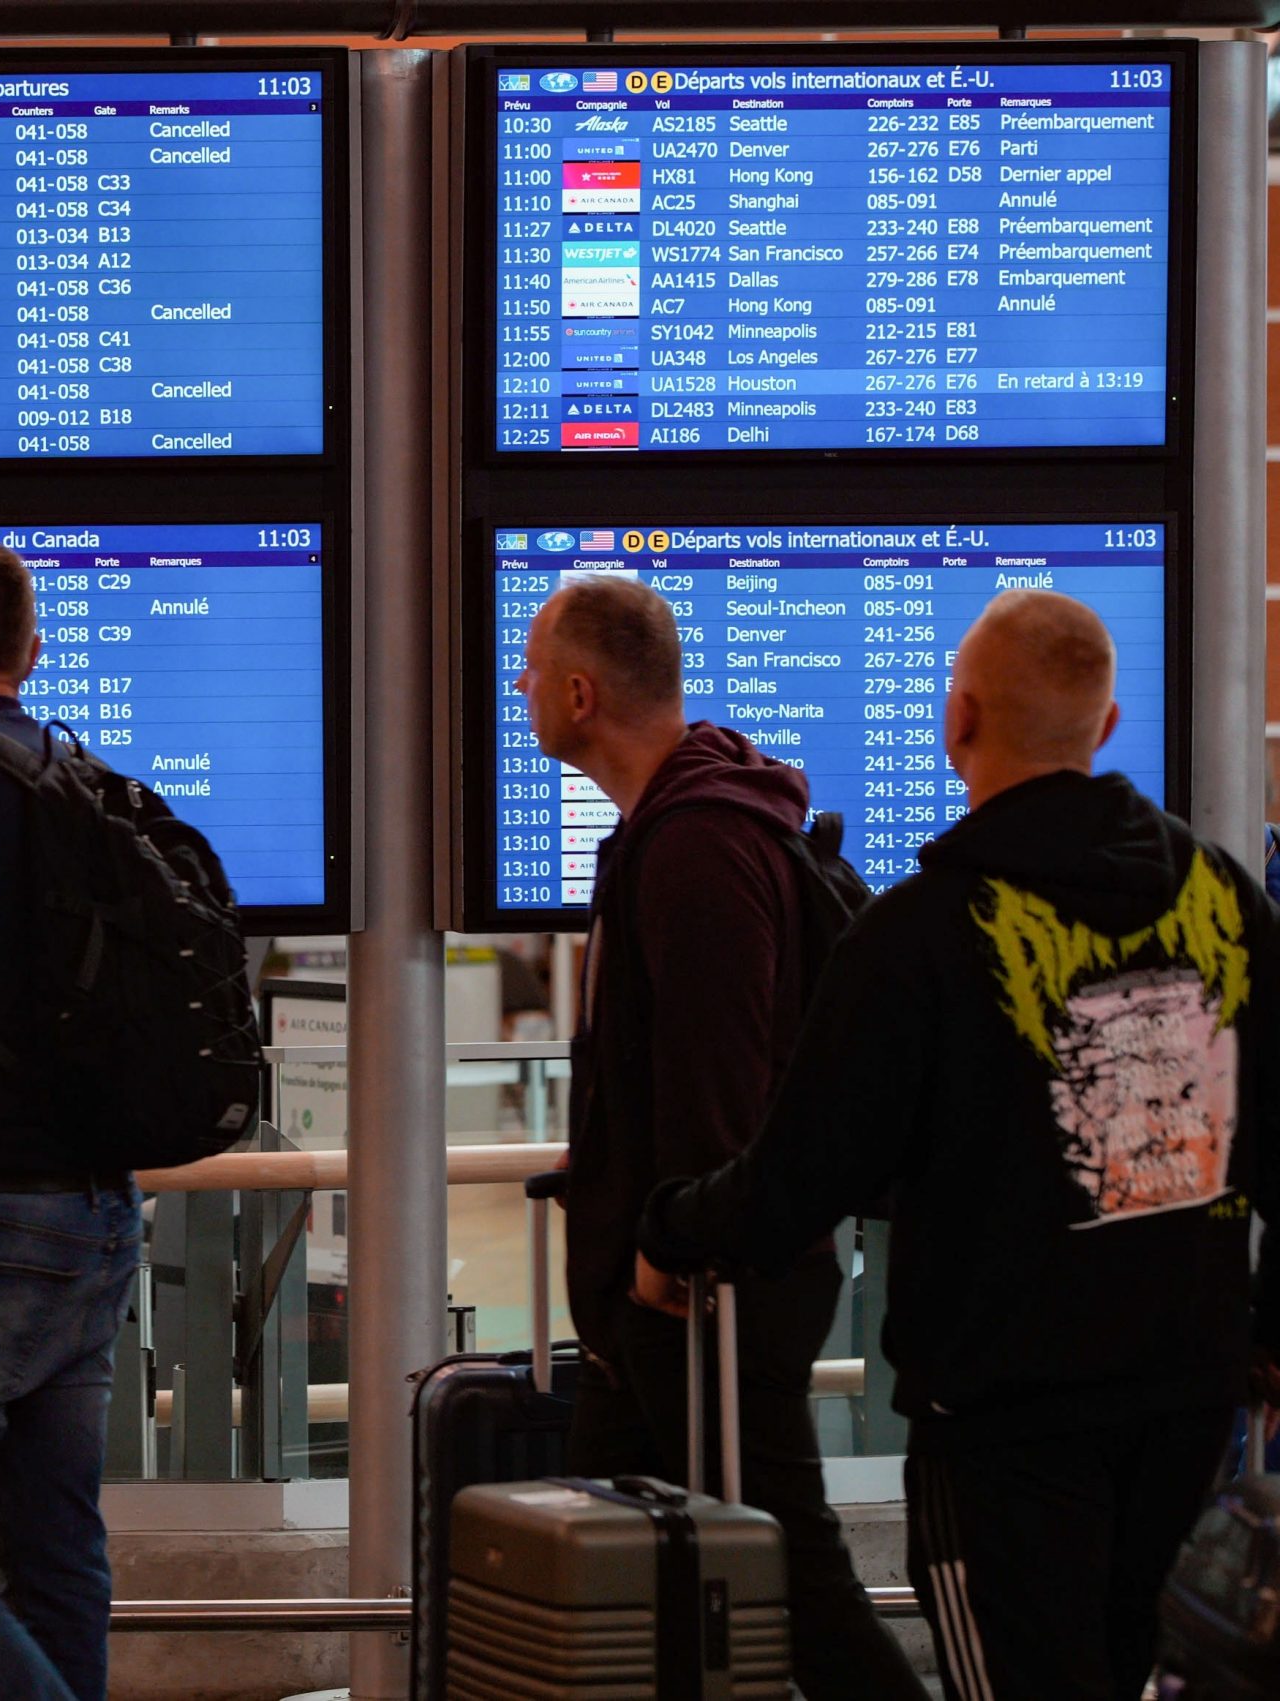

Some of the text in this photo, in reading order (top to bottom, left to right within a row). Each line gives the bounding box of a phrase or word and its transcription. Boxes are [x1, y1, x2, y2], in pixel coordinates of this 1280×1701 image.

[259, 77, 310, 95] 11:03
[631, 66, 1162, 93] D E Départs vols internationaux et É.-U. 11:03
[12, 107, 53, 115] Counters
[94, 106, 116, 115] Gate
[150, 105, 189, 114] Remarks
[16, 124, 87, 140] 041-058
[150, 121, 230, 137] Cancelled
[505, 113, 1154, 133] 10:30 Alaska AS2185 Seattle 226-232 E85 Préembarquement
[505, 144, 551, 159] 11:00
[653, 142, 717, 158] UA2470
[730, 142, 789, 157] Denver
[868, 141, 938, 157] 267-276
[949, 140, 980, 156] E76
[1001, 140, 1037, 155] Parti
[17, 202, 88, 218] 041-058
[98, 201, 131, 216] C34
[504, 217, 1152, 237] 11:27 DELTA DL4020 Seattle 233-240 E88 Préembarquement
[18, 410, 89, 426] 009-012
[101, 409, 131, 424] B18
[3, 531, 25, 548] du
[32, 530, 99, 547] Canada
[259, 529, 310, 546] 11:03
[503, 572, 1053, 592] 12:25 AC29 Beijing 085-091 Annulé
[727, 600, 933, 616] Seoul-Incheon 085-091
[100, 678, 131, 693] B17
[727, 704, 933, 721] Tokyo-Narita 085-091
[152, 753, 210, 770] Annulé
[504, 755, 935, 773] 13:10 241-256
[290, 1018, 307, 1030] AIR
